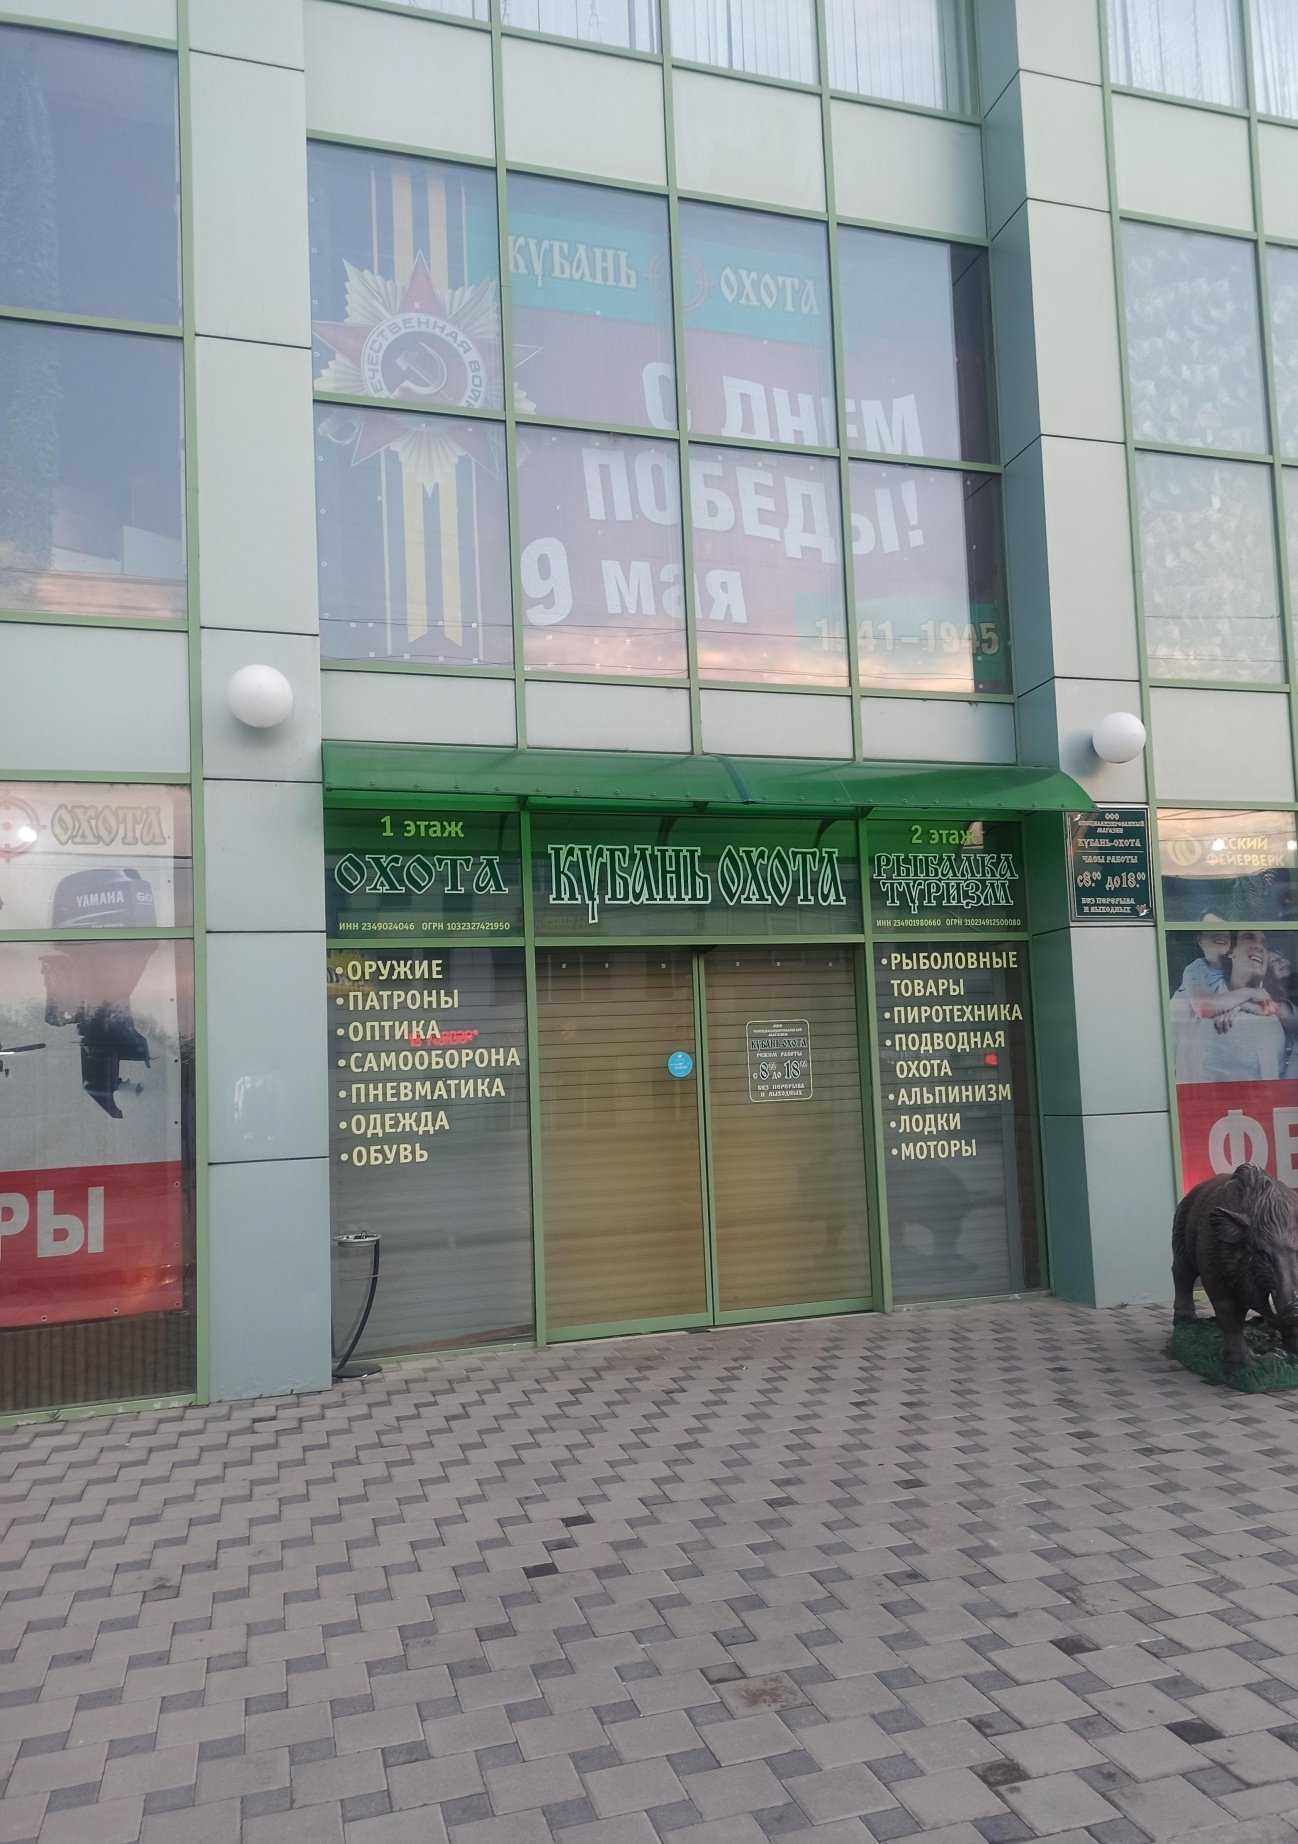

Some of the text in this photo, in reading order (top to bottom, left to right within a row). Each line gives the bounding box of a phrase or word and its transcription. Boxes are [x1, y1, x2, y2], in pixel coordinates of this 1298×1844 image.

[507, 235, 819, 316] КУБАНЬ ОХОТА
[581, 448, 925, 564] ПОБЕДЫ!
[520, 537, 573, 626] 9
[51, 803, 167, 847] ОХОТА
[380, 815, 464, 838] 1 этаж
[911, 824, 975, 845] 2 этаж
[334, 853, 509, 895] ОХОТА
[873, 853, 1019, 880] РЫБАЛКА
[548, 845, 846, 924] КУБАНЬ ОХОТА
[76, 890, 125, 907] YAMAHA
[880, 879, 1014, 914] ТУРИЗМ
[339, 922, 359, 930] ИНН
[361, 922, 415, 931] 2349024046
[422, 922, 444, 930] ОГРН
[876, 919, 891, 927] ИНН
[945, 918, 962, 926] ОГРН
[347, 960, 443, 981] ОРУЖИЕ
[890, 951, 1018, 970] РЫБОЛОВНЫЕ
[890, 978, 965, 997] ТОВАРЫ
[349, 989, 459, 1011] ПАТРОНЫ
[893, 1003, 1023, 1024] ПИРОТЕХНИКА
[348, 1020, 441, 1041] ОПТИКА
[895, 1031, 1005, 1053] ПОДВОДНАЯ
[350, 1047, 521, 1073] САМООБОРОНА
[896, 1060, 952, 1078] ОХОТА
[351, 1078, 506, 1103] ПНЕВМАТИКА
[897, 1083, 1011, 1105] АЛЬПИНИЗМ
[351, 1110, 450, 1138] ОДЕЖДА
[899, 1113, 961, 1135] ЛОДКИ
[352, 1143, 429, 1167] ОБУВЬ
[901, 1139, 976, 1160] МОТОРЫ
